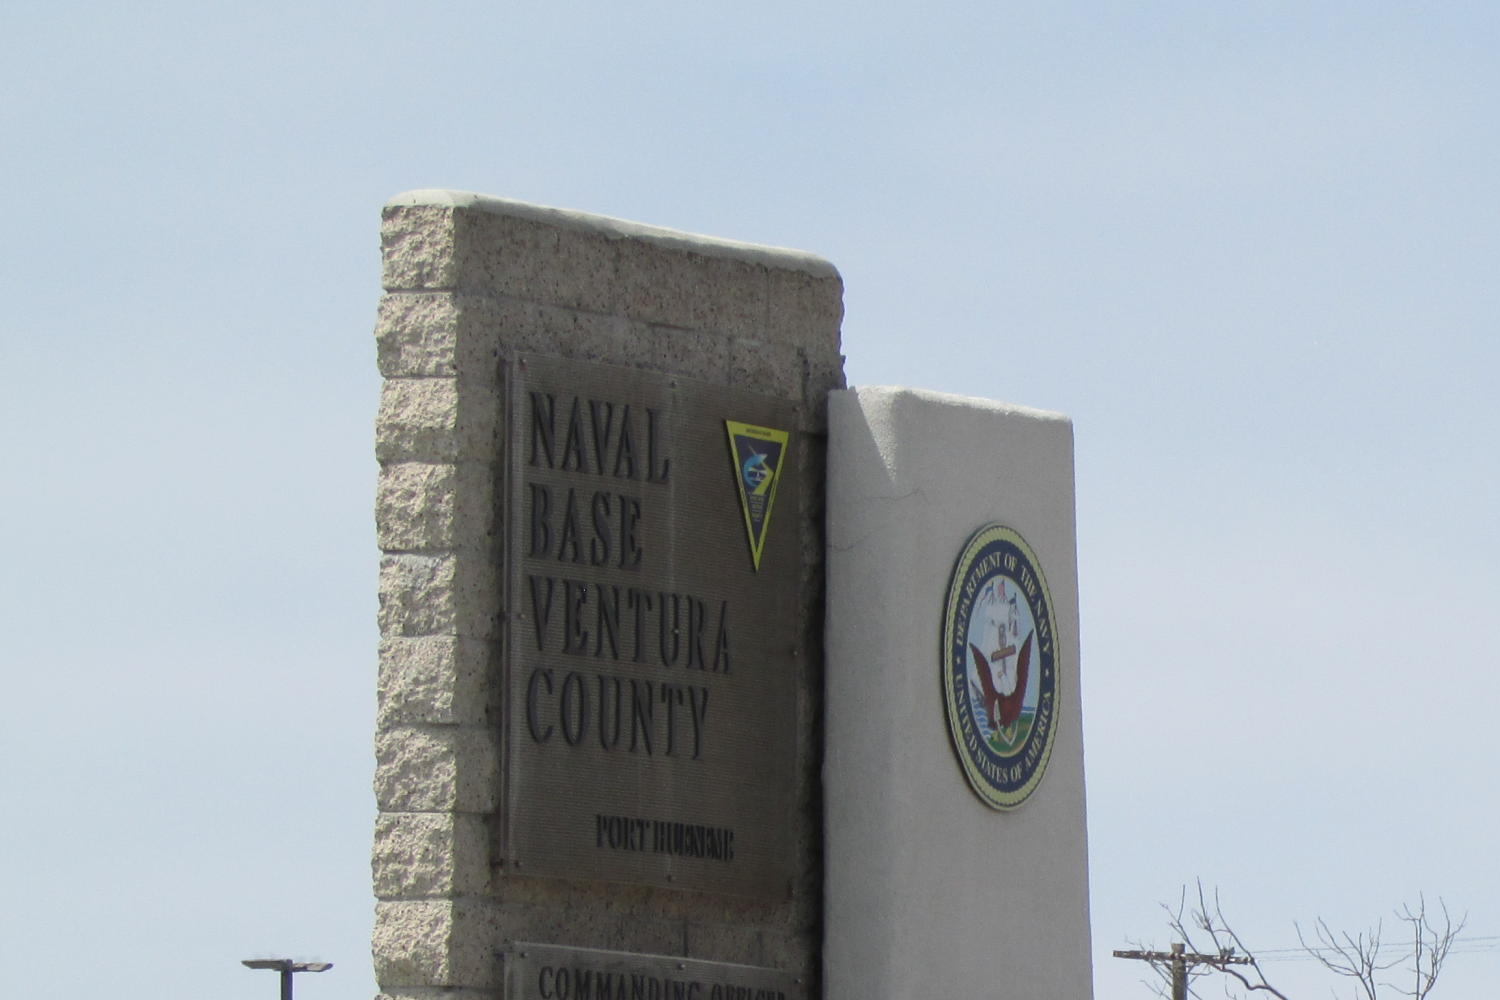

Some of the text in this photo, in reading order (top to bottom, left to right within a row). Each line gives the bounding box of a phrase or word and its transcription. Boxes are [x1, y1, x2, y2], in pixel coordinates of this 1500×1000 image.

[529, 391, 670, 485] NAVAL
[529, 482, 642, 572] BASE
[529, 575, 731, 675] VENTURA
[527, 667, 709, 760] COUNTY
[596, 814, 650, 852] PORT
